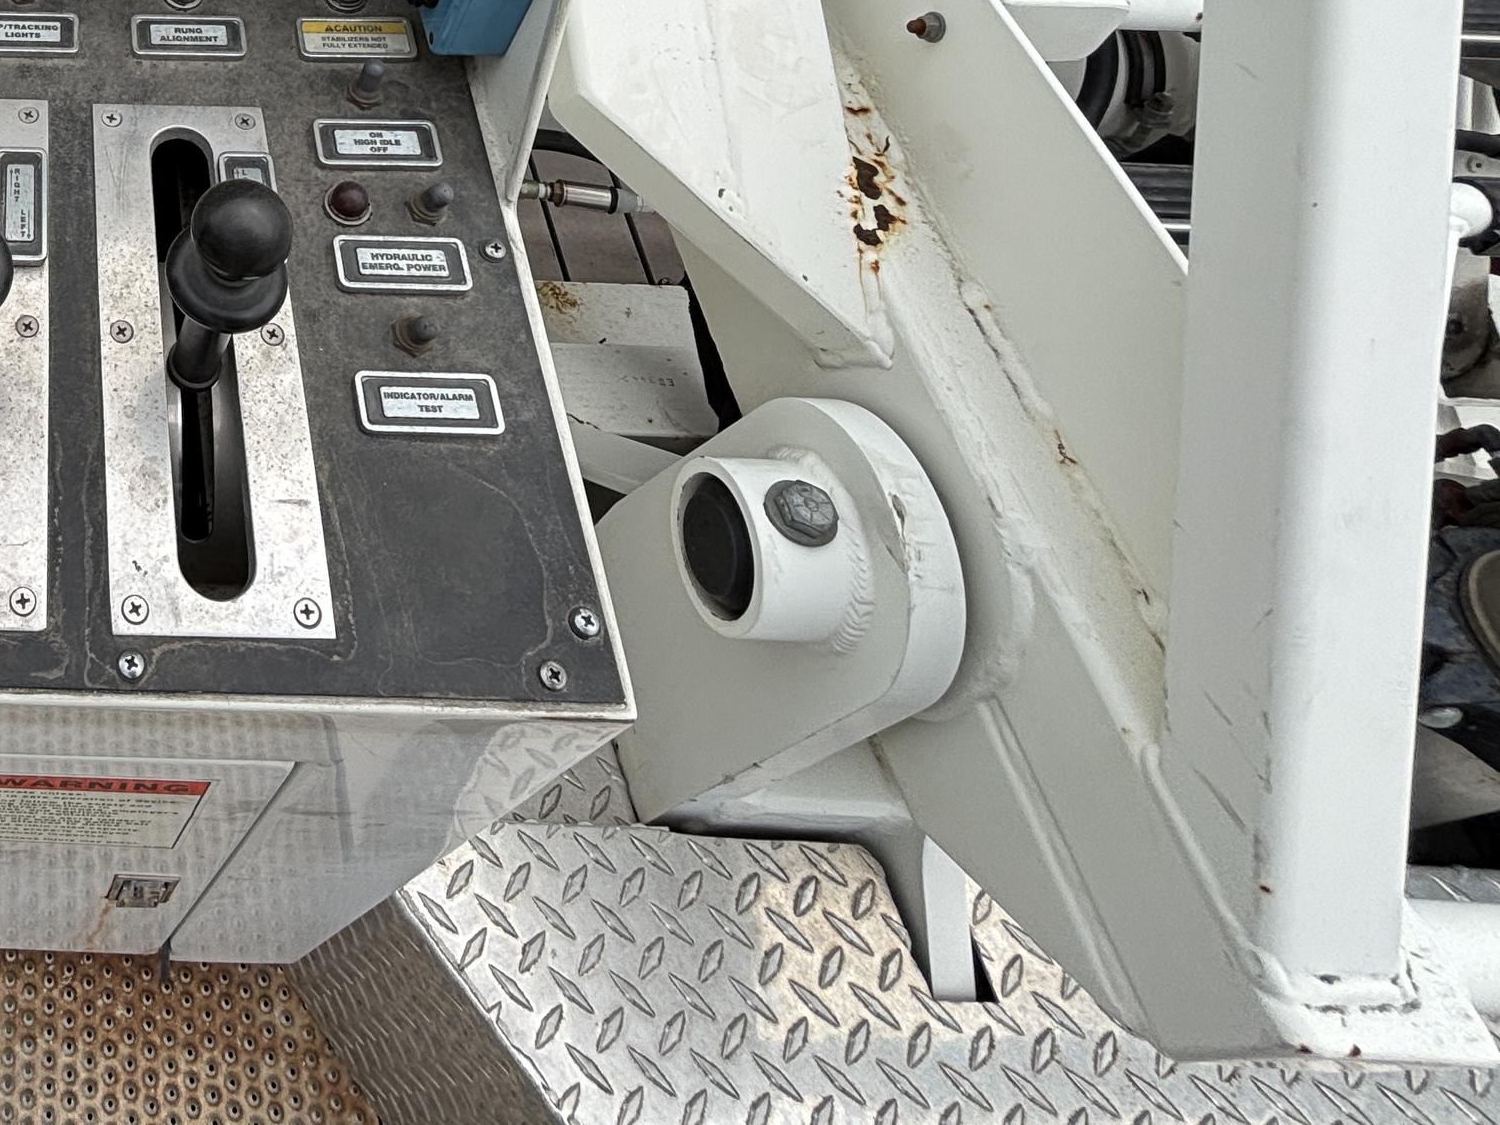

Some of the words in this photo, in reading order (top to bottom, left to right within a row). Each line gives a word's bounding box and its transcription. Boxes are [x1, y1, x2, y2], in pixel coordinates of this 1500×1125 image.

[174, 27, 203, 35] RUNG
[334, 24, 382, 32] CAUTION
[4, 31, 41, 39] LIGHTS
[159, 35, 219, 43] ALIGNMENT
[353, 138, 377, 146] HIGH
[370, 252, 433, 262] HYDRAULIC
[361, 262, 404, 271] EMERG.
[406, 263, 447, 272] POWER
[383, 392, 474, 402] INDICATOR/ALARM
[417, 405, 444, 413] TEST
